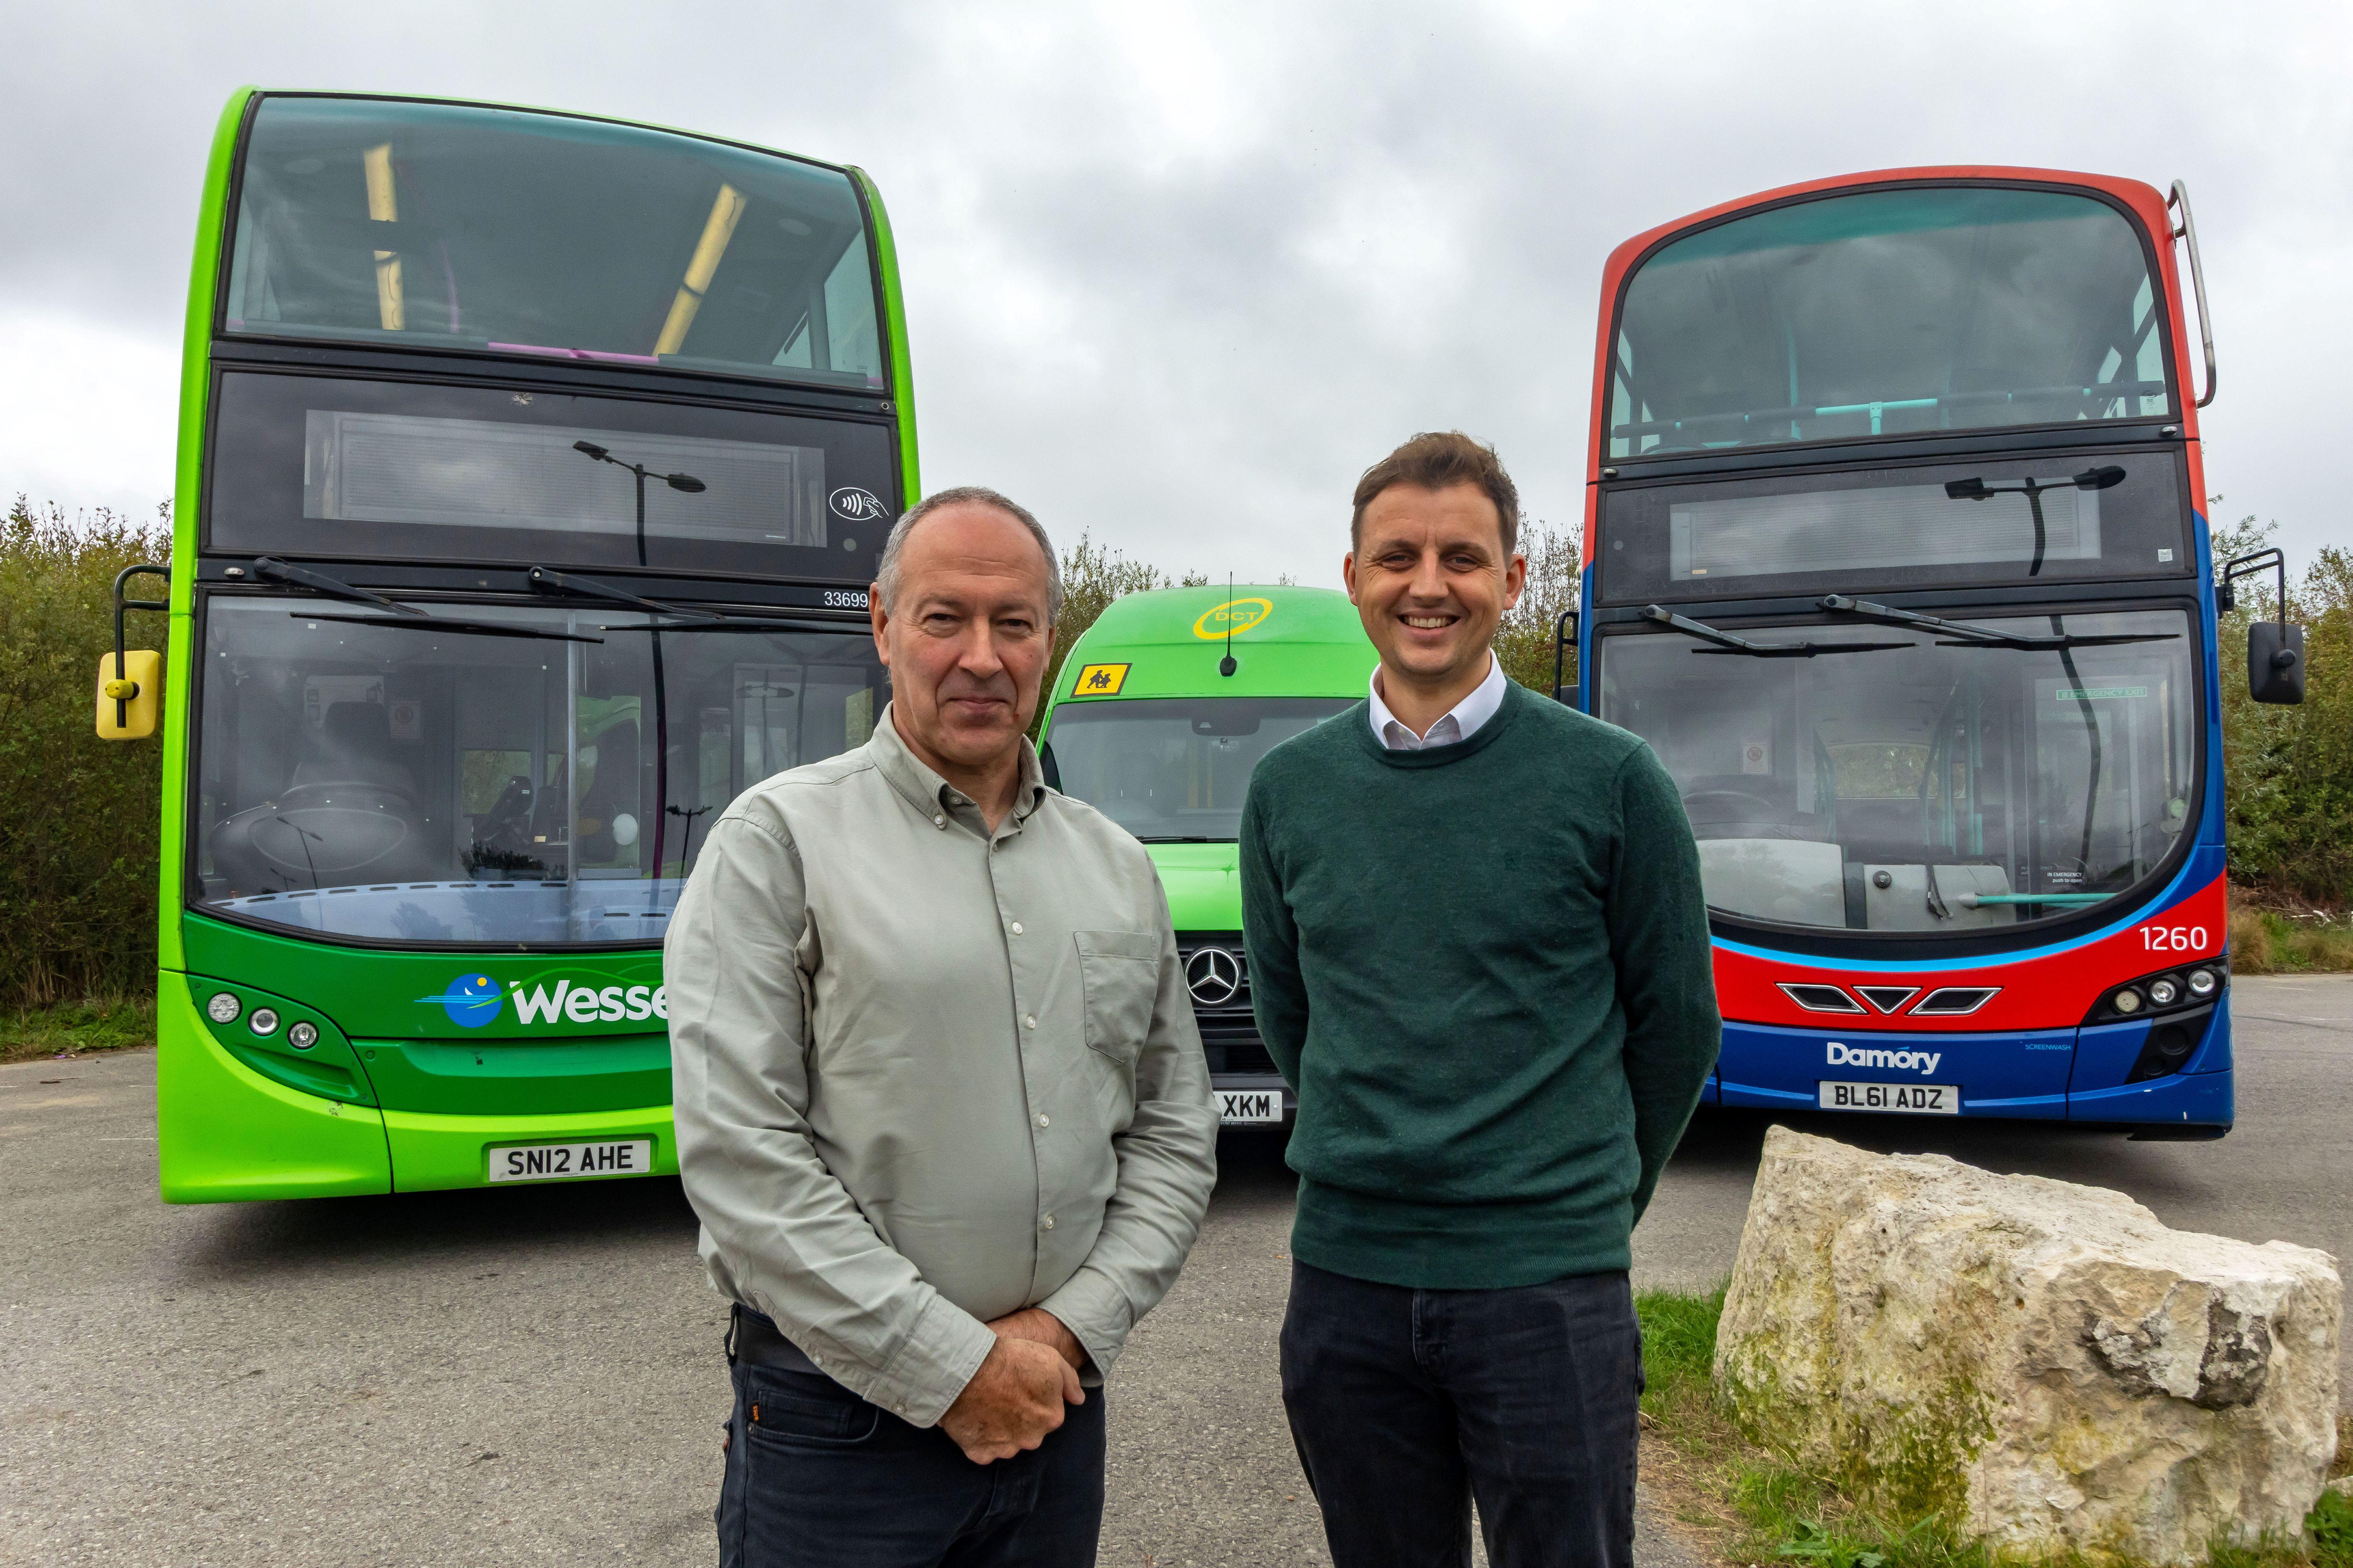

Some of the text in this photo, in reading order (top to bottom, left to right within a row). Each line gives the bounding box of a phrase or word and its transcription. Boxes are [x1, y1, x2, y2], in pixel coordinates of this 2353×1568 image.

[824, 591, 868, 608] 33699
[1215, 612, 1258, 621] DCT
[2070, 689, 2122, 698] EMERGENCY
[2139, 927, 2207, 950] 1260
[1223, 1095, 1270, 1117] XKM
[1835, 1085, 1942, 1109] BL61 ADZ
[507, 1145, 633, 1176] SN12 AHE
